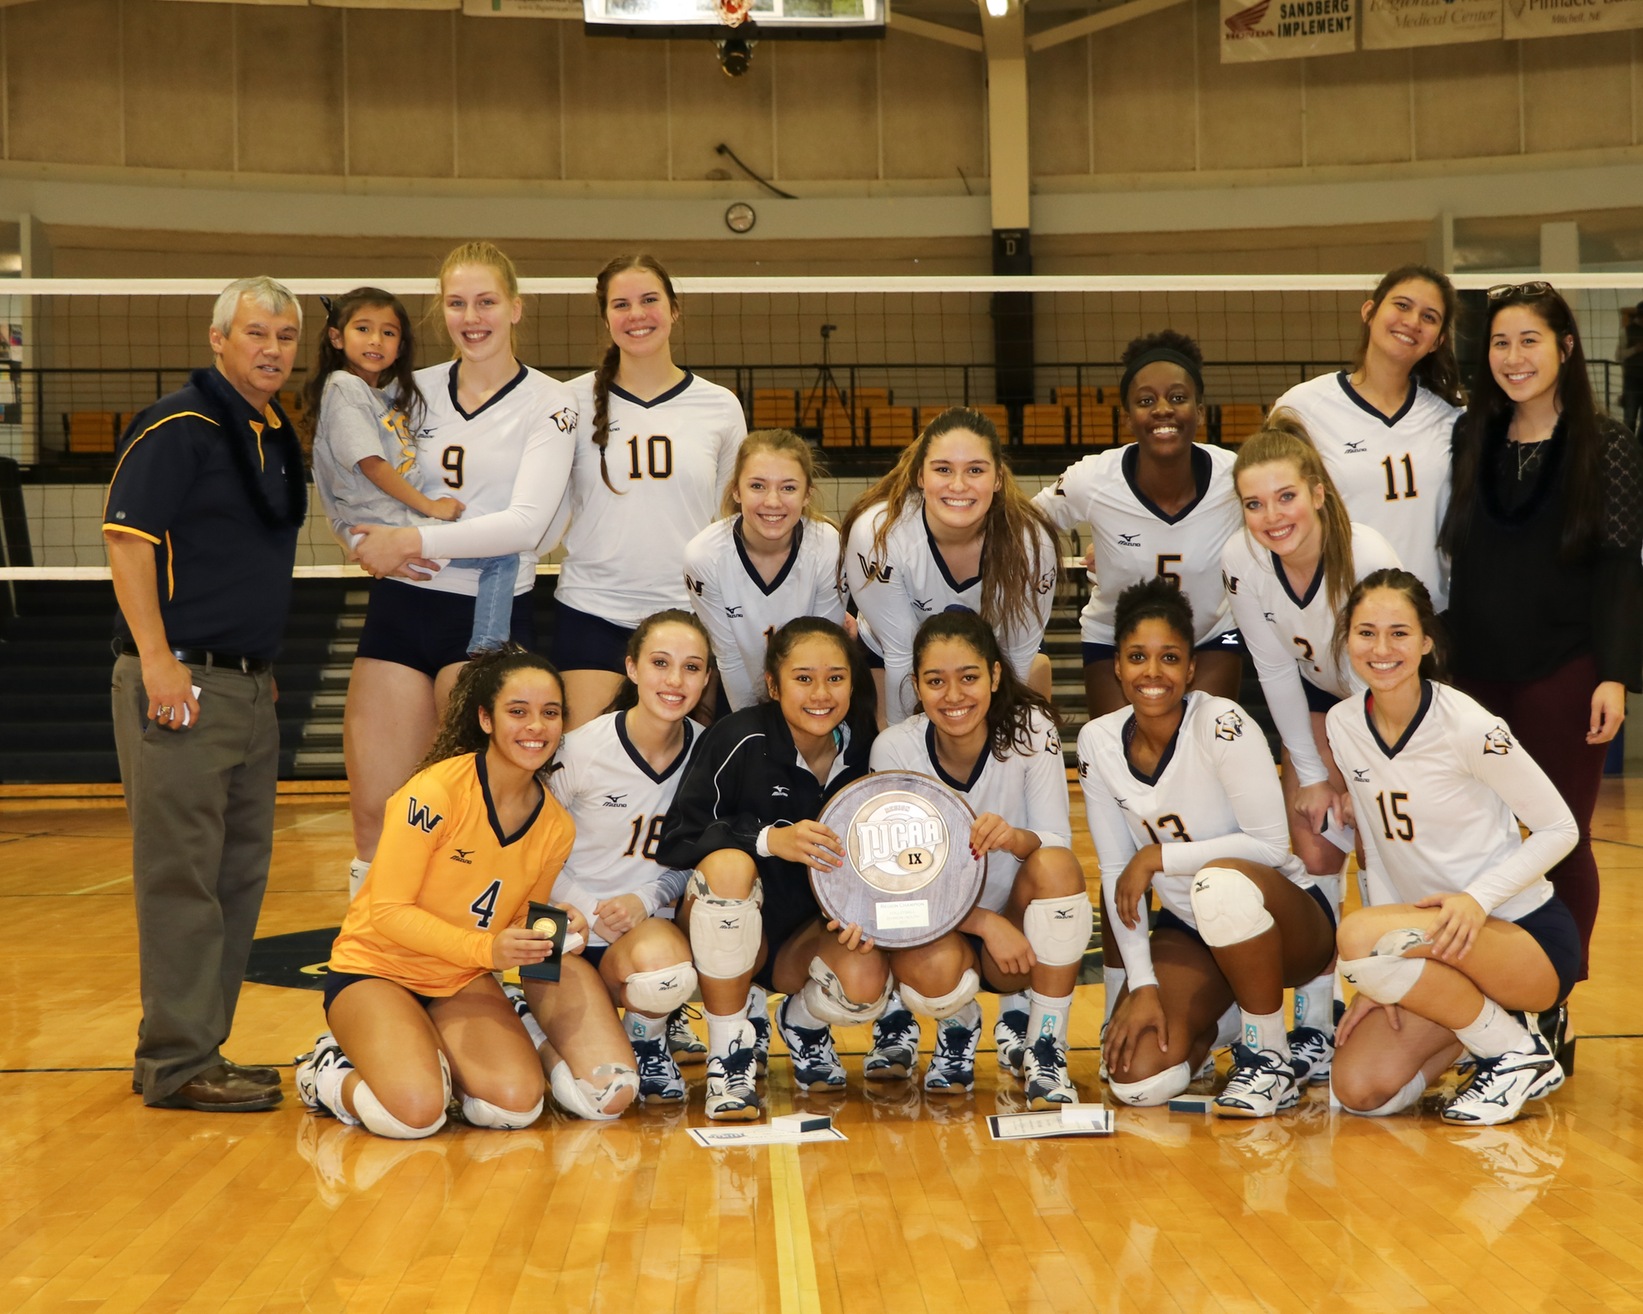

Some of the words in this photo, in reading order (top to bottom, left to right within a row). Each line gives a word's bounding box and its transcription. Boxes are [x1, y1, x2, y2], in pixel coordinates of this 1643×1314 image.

[1277, 16, 1352, 38] IMPLEMENT
[1280, 0, 1349, 19] SANDBERG
[1394, 11, 1446, 28] Medical
[1450, 9, 1497, 24] Center
[1225, 30, 1275, 40] HONDA
[1005, 239, 1016, 256] D
[441, 444, 465, 490] 9
[627, 434, 672, 480] 10
[1381, 452, 1419, 502] 11
[1156, 553, 1182, 588] 5
[407, 796, 444, 834] W
[1141, 813, 1195, 845] 13
[1375, 790, 1416, 843] 15
[857, 817, 943, 871] NJCAA
[908, 852, 923, 865] IX
[469, 878, 502, 930] 4
